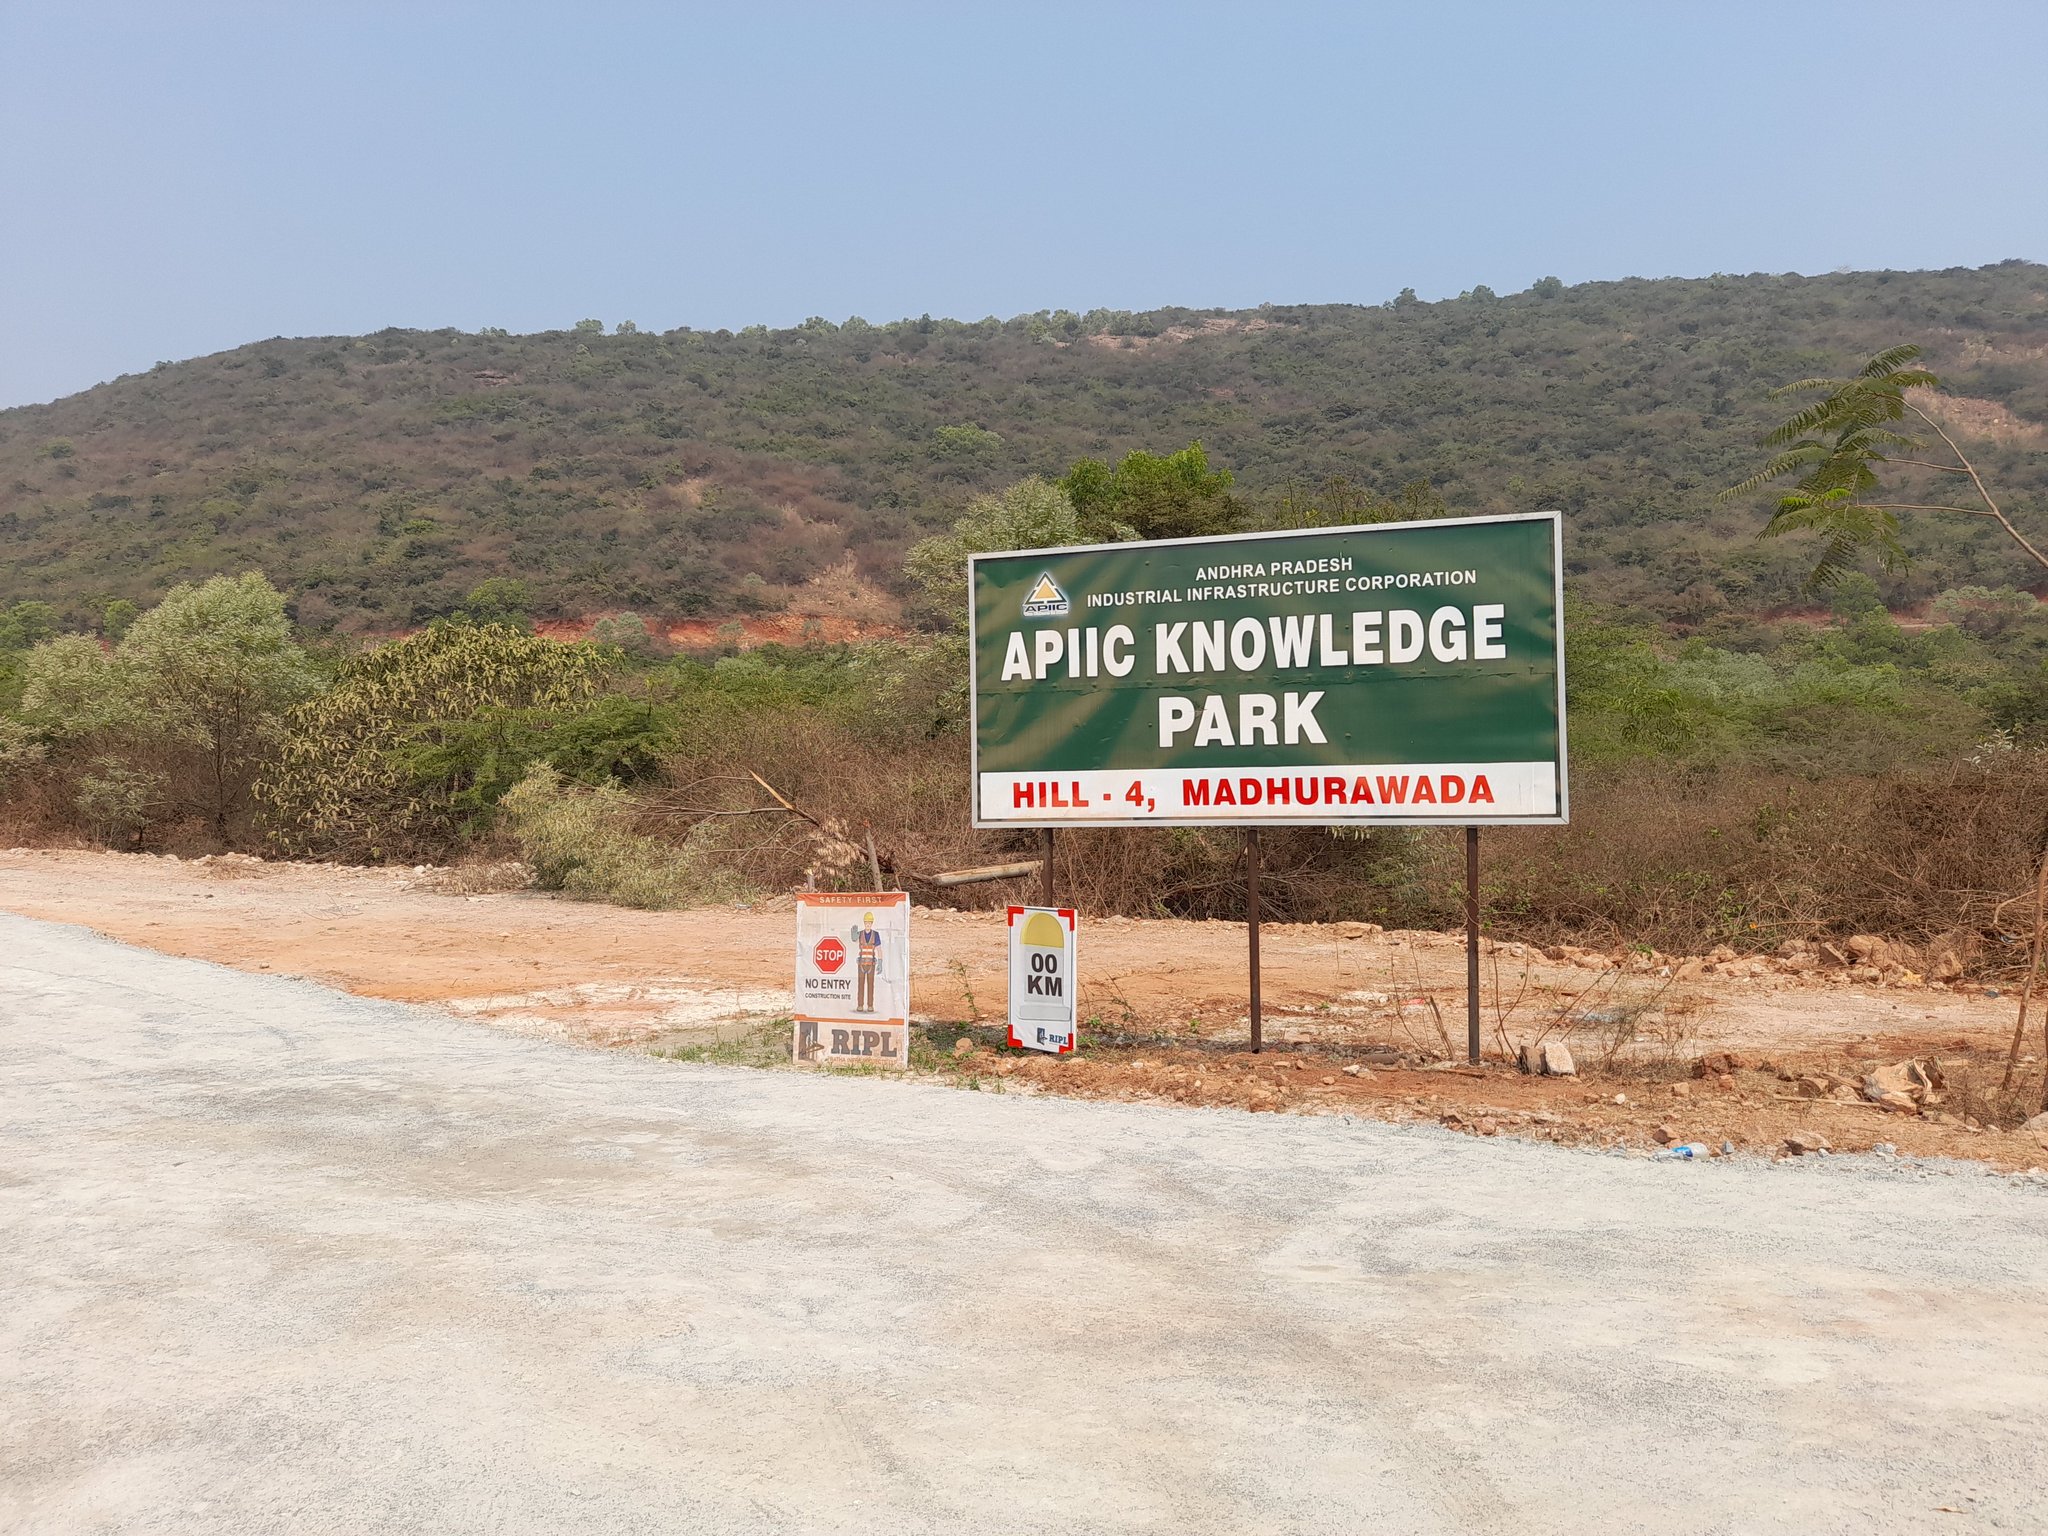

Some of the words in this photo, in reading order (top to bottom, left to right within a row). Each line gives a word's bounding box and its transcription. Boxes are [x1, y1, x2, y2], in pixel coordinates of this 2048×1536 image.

[1195, 563, 1267, 581] ANDHRA
[1270, 557, 1353, 575] PRADESH
[1087, 589, 1183, 607] INDUSTRIAL
[1187, 579, 1340, 601] INFRASTRUCTURE
[1345, 570, 1477, 593] CORPORATION
[1024, 603, 1068, 612] APIIC
[1001, 624, 1135, 682] APIIC
[1155, 604, 1507, 674] KNOWLEDGE
[1158, 691, 1328, 748] PARK
[1013, 782, 1089, 808] HILL
[1125, 781, 1156, 811] 4,
[1183, 775, 1494, 806] MADHURAWADA
[819, 896, 852, 904] SAFETY
[857, 896, 882, 904] FIRST
[816, 949, 843, 962] STOP
[805, 979, 818, 989] NO
[821, 979, 851, 990] ENTRY
[1027, 975, 1062, 997] KM
[831, 1029, 897, 1058] RIPL
[1049, 1034, 1068, 1045] RIPL
